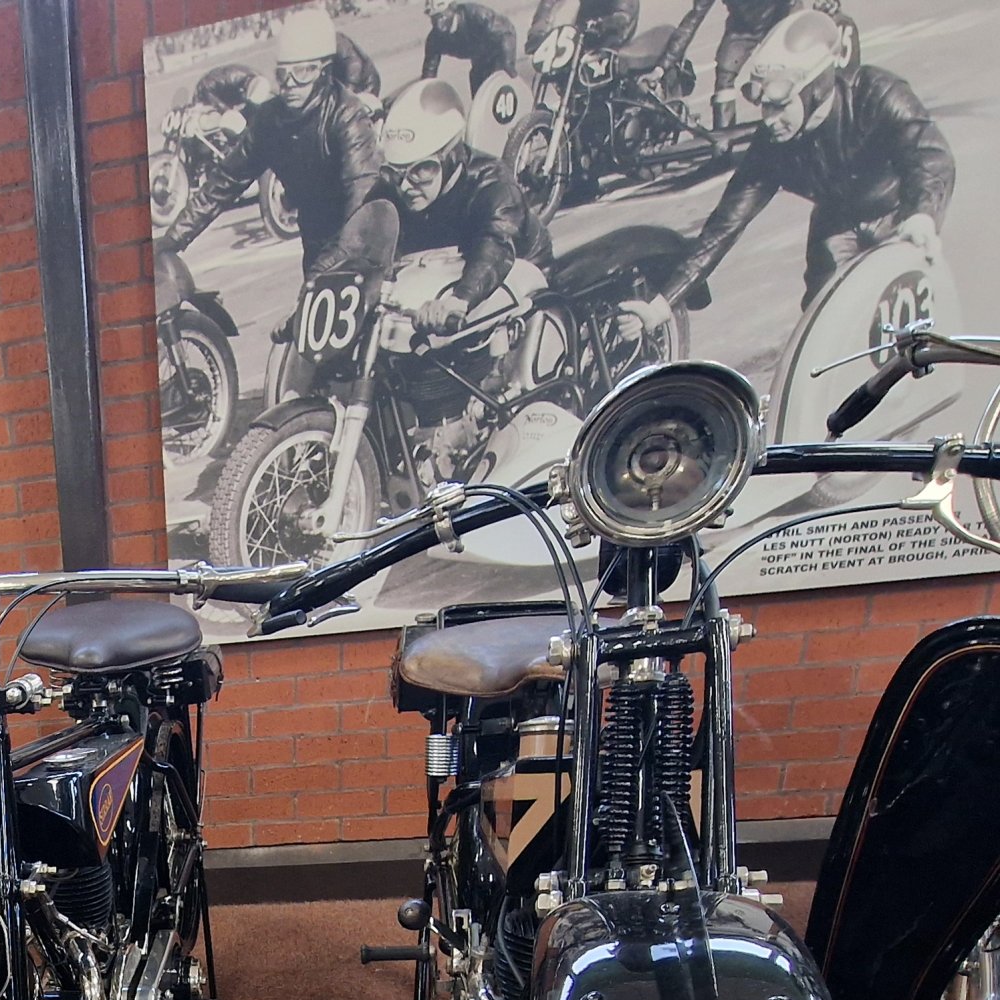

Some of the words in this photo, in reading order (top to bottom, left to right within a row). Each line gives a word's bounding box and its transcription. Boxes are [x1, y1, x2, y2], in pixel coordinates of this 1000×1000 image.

[533, 26, 577, 73] 45
[496, 92, 514, 118] 40
[298, 285, 360, 353] 103
[763, 541, 785, 552] LES
[790, 538, 825, 550] NUTT
[828, 531, 892, 547] (NORTON)
[896, 526, 940, 540] READY
[807, 523, 848, 536] SMITH
[851, 519, 878, 531] AND
[800, 552, 812, 561] IN
[818, 549, 843, 559] THE
[847, 545, 884, 556] FINAL
[889, 543, 905, 552] OF
[911, 539, 935, 549] THE
[759, 563, 818, 577] SCRATCH
[821, 559, 864, 571] EVENT
[868, 557, 883, 566] AT
[888, 550, 948, 564] BROUGH,
